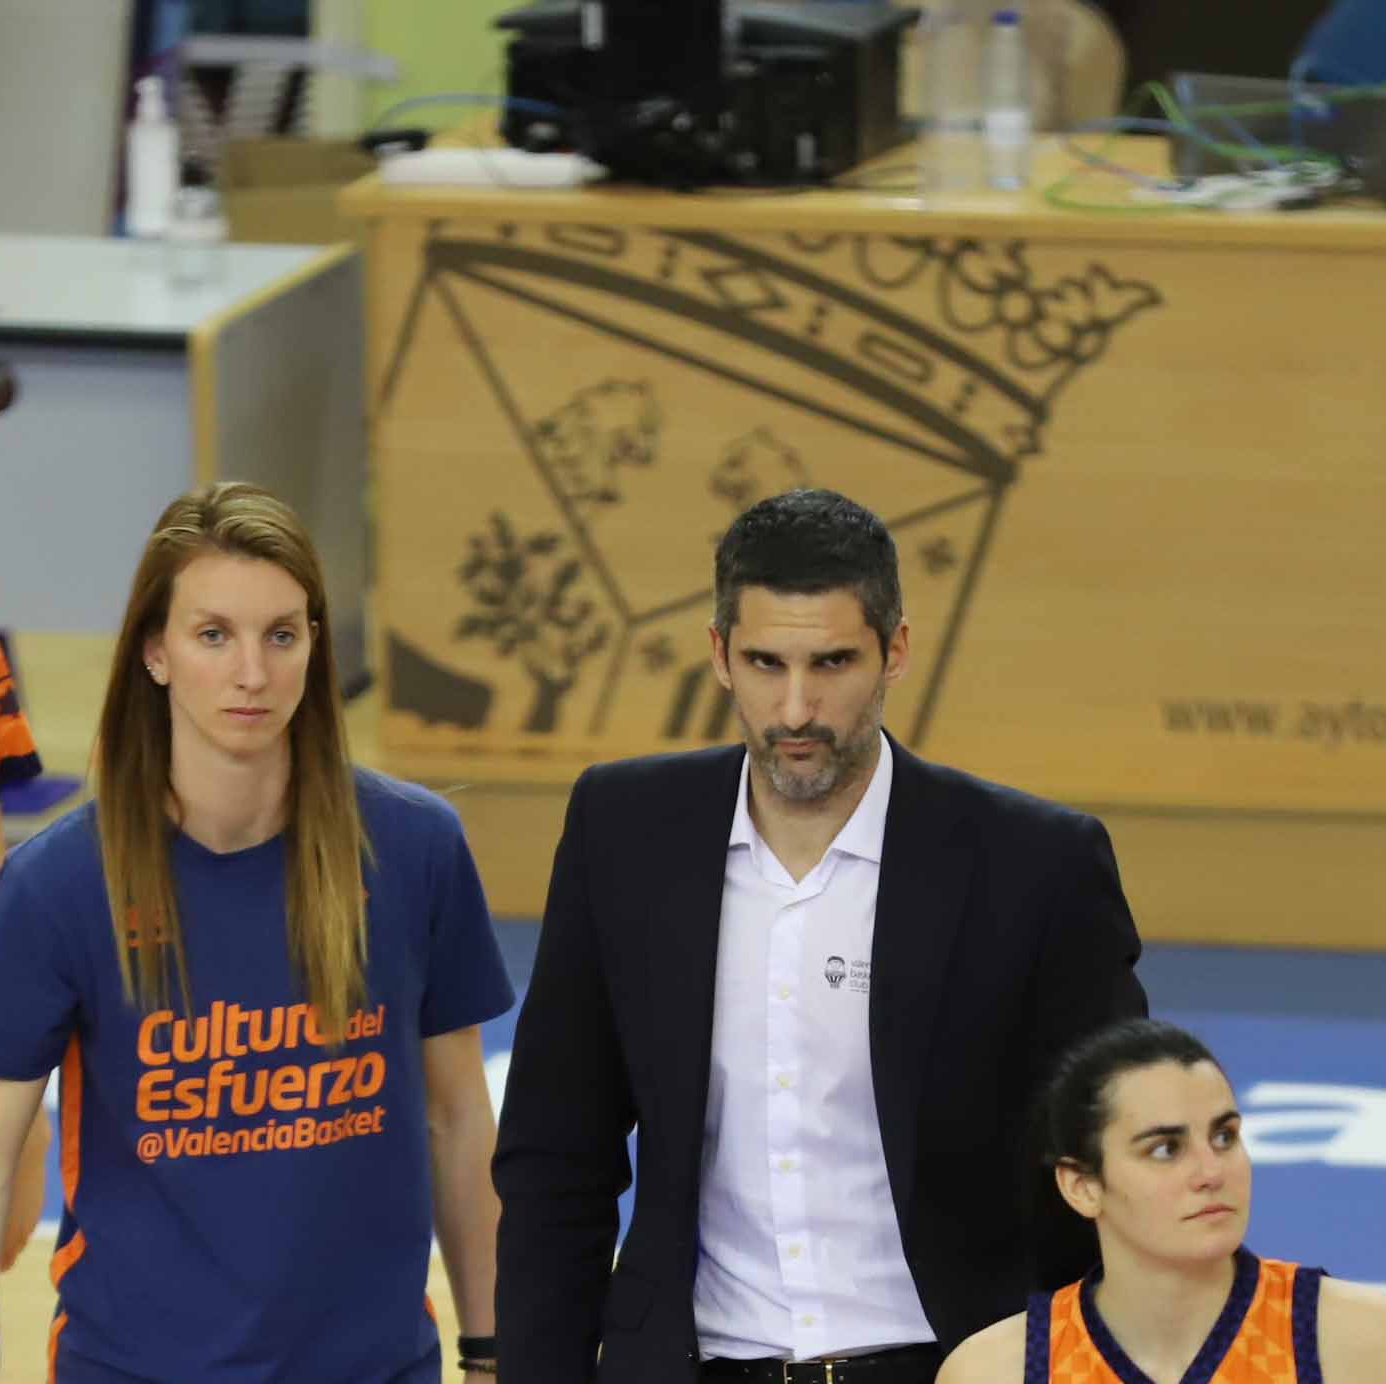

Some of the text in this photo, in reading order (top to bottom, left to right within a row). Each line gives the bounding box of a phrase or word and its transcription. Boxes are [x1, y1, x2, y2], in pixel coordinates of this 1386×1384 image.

[346, 1004, 385, 1041] del
[134, 1051, 387, 1122] Esfuerzo
[136, 1105, 386, 1164] @ValenciaBasket
